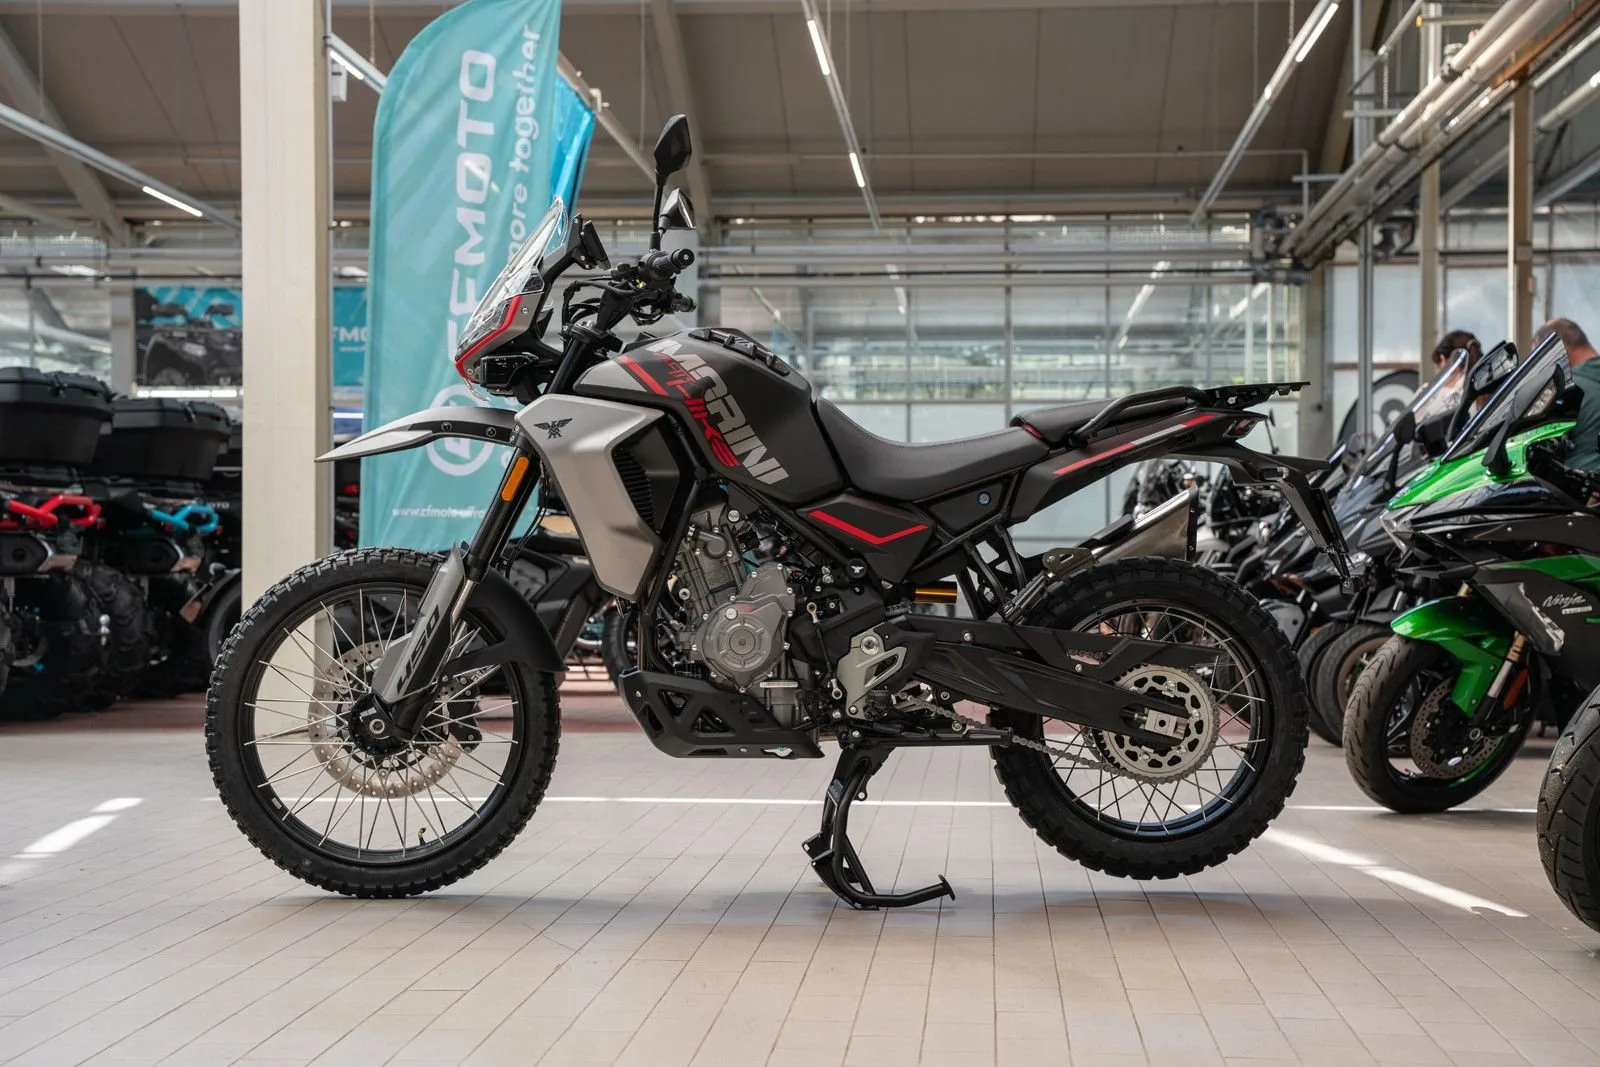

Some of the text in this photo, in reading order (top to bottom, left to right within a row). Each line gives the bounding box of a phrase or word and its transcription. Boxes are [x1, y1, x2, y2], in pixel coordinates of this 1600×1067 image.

[509, 23, 541, 173] together
[645, 339, 789, 485] MORINI
[397, 604, 440, 695] 450
[1542, 592, 1586, 609] Ninja
